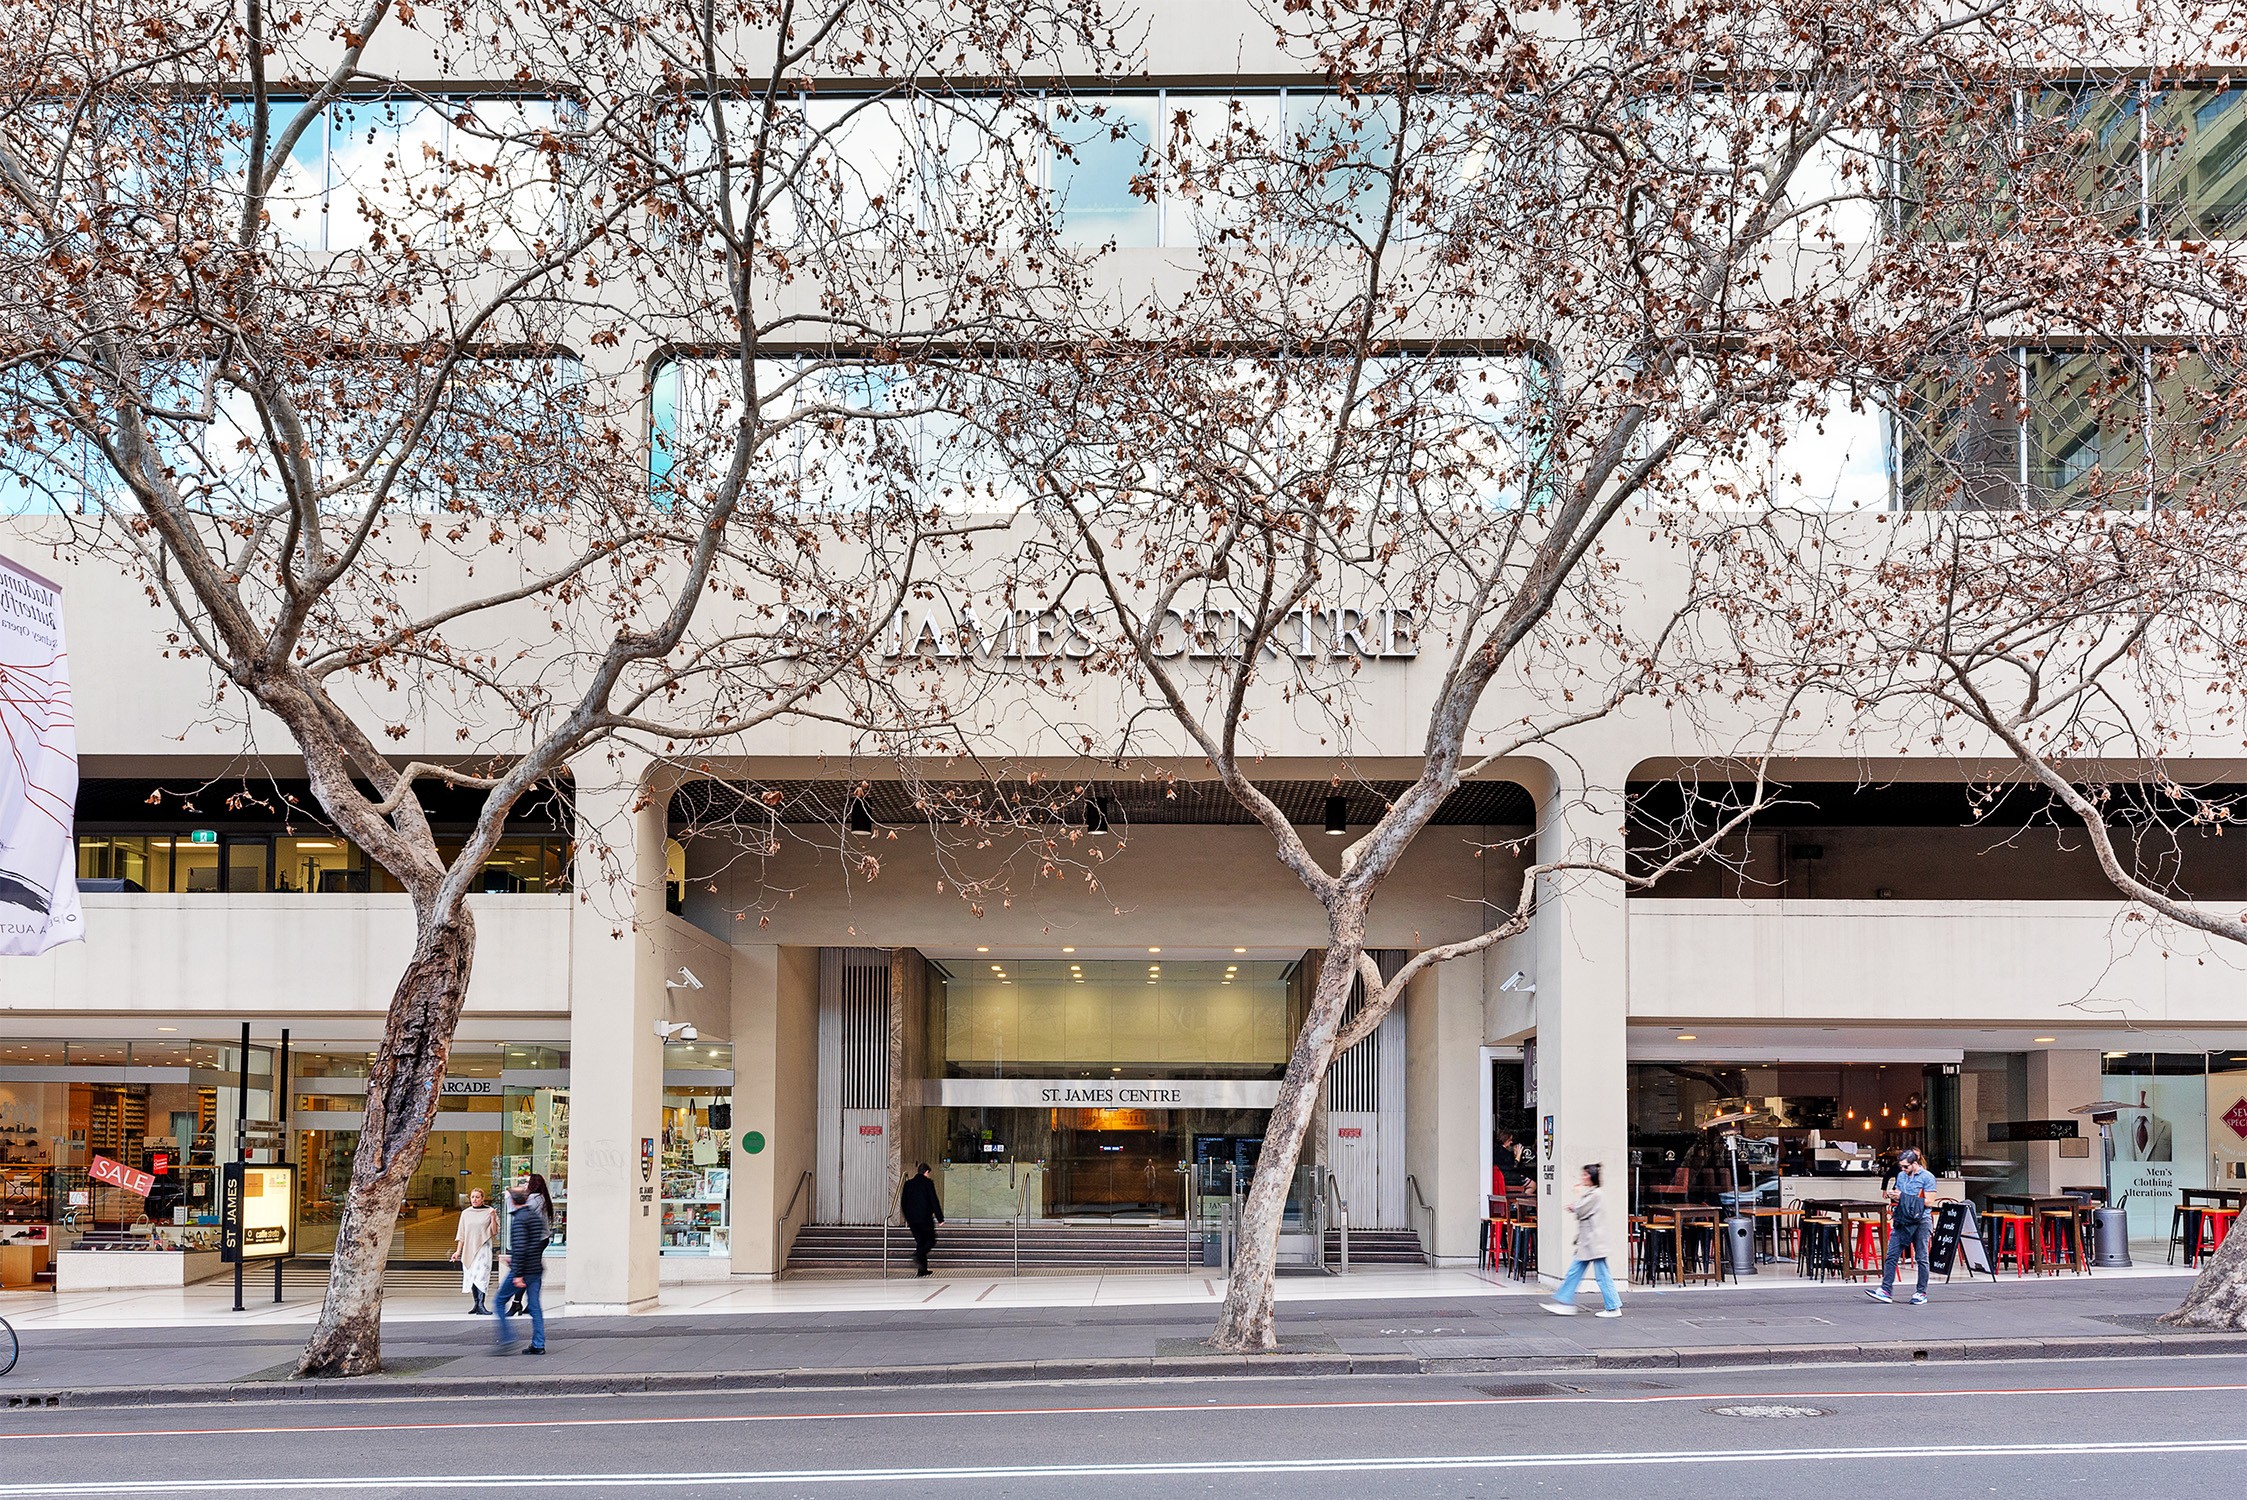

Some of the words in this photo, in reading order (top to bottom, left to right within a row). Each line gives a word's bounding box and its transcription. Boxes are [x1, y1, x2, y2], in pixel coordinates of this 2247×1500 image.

[883, 607, 1098, 658] JAMES
[1144, 607, 1419, 659] CENTRE
[441, 1082, 491, 1092] ARCADE
[1042, 1089, 1061, 1102] ST.
[1065, 1089, 1113, 1102] JAMES
[1119, 1089, 1181, 1102] CENTRE
[96, 1160, 149, 1192] SALE
[2146, 1168, 2172, 1176] Men's
[2133, 1178, 2172, 1188] Clothing
[2124, 1188, 2172, 1196] Alterations
[227, 1179, 238, 1224] JAMES
[226, 1230, 236, 1248] ST
